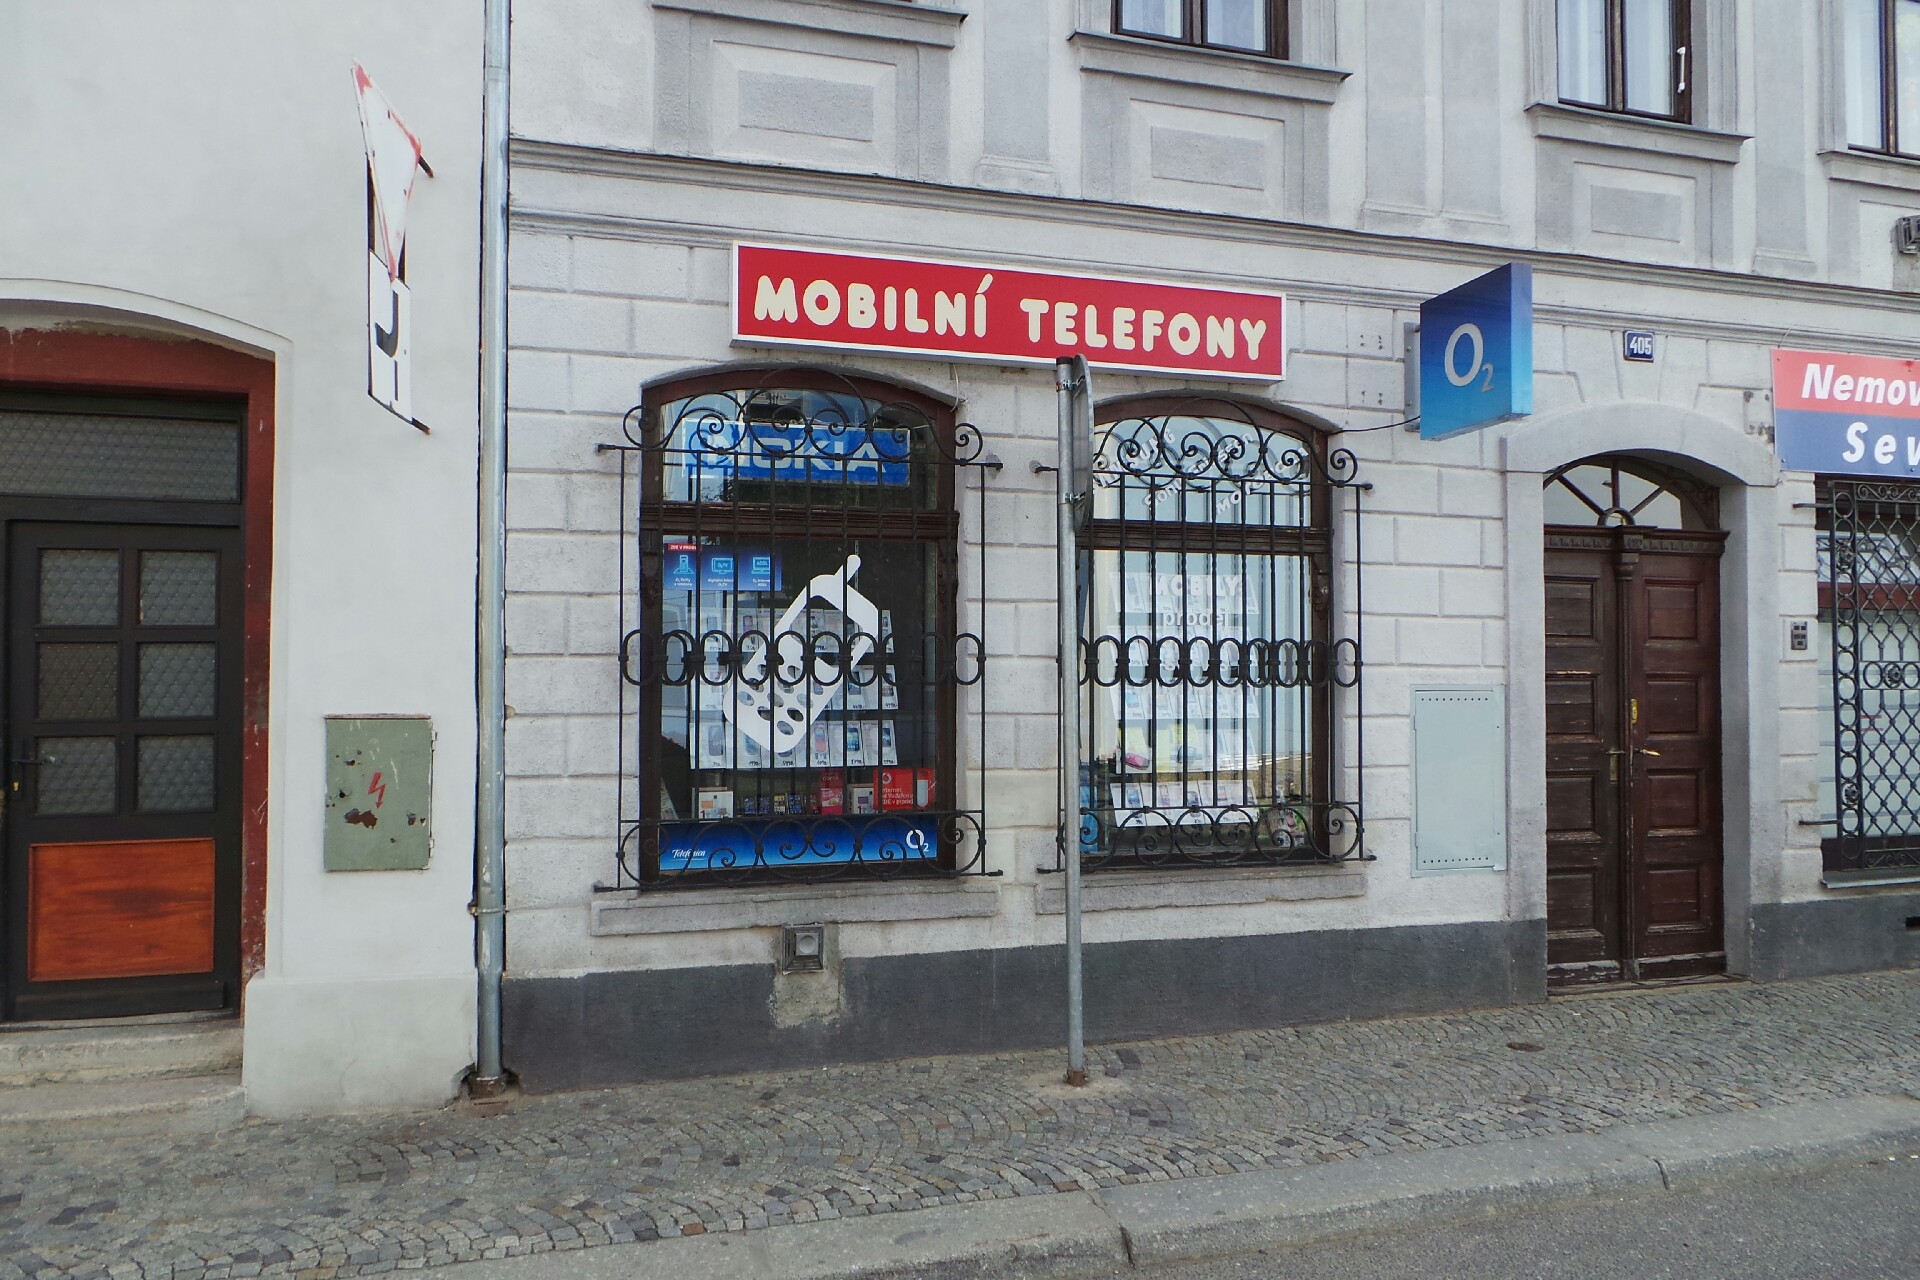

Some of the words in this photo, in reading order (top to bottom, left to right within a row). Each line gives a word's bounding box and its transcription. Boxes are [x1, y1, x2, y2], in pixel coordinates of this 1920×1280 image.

[754, 273, 994, 338] MOBILNÍ
[1019, 298, 1267, 362] TELEFONY
[1629, 336, 1652, 355] 405
